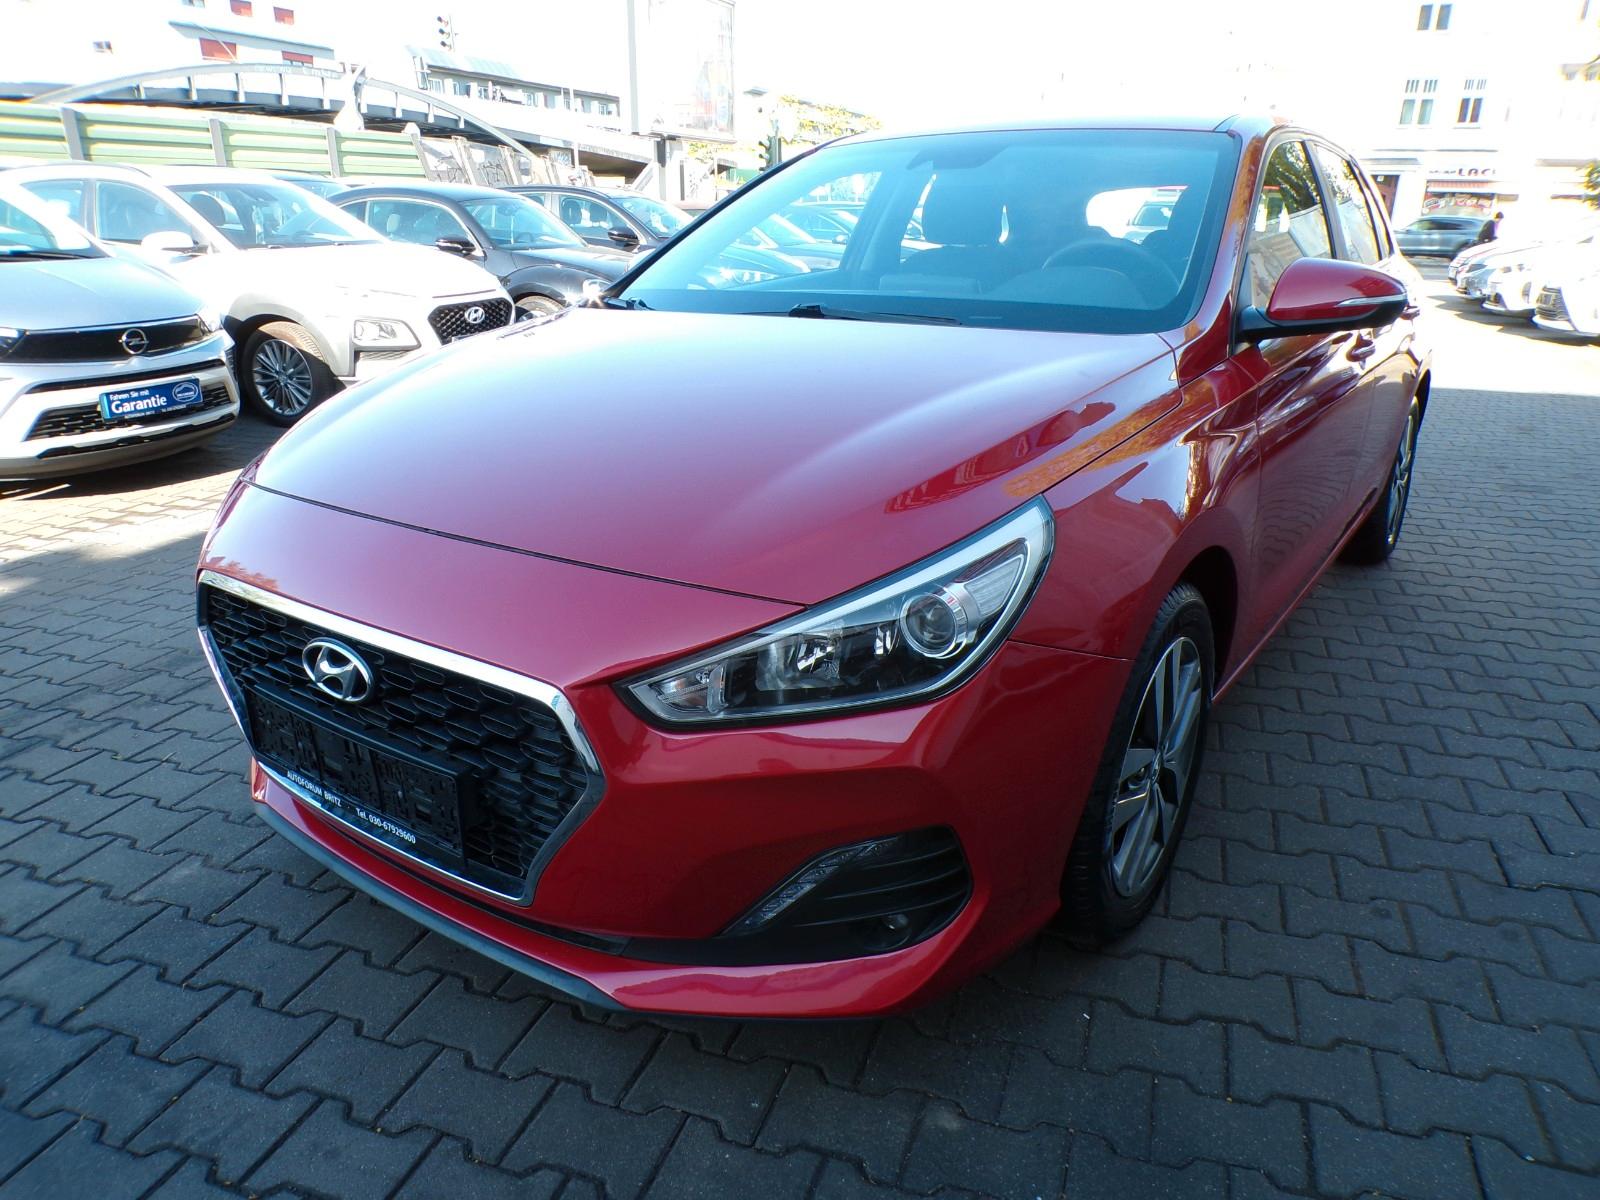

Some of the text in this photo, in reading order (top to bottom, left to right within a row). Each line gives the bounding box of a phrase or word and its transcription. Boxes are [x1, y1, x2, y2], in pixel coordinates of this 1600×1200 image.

[110, 393, 129, 401] Fahren
[130, 390, 139, 398] Sie
[111, 394, 168, 414] Garantie
[287, 770, 416, 844] AUTOFORUM BRITZ Tel. 030-67929600
